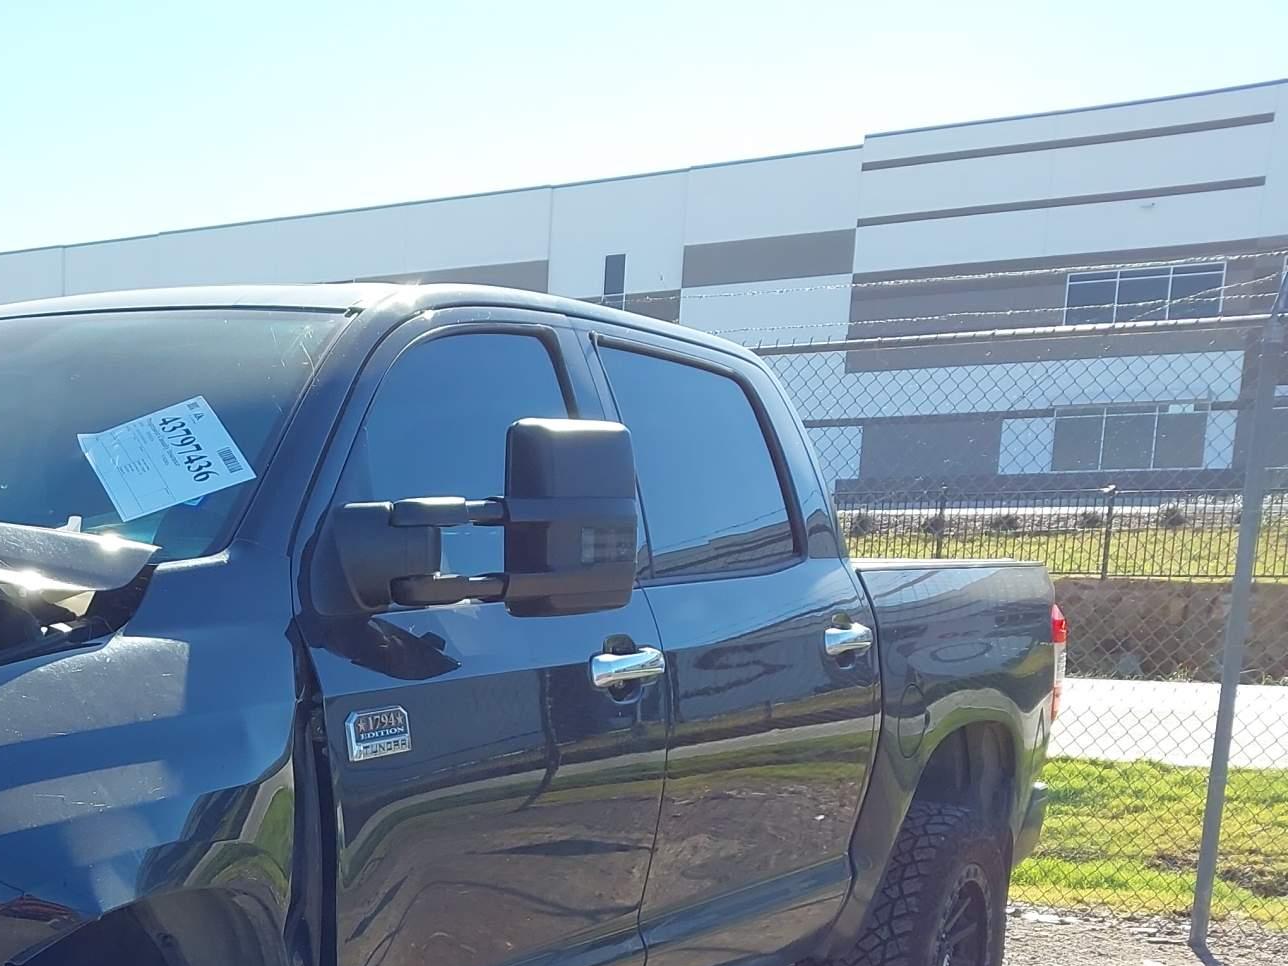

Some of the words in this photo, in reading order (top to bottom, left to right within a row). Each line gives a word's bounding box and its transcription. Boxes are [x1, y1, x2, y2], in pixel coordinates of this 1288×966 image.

[159, 416, 219, 482] 43797436
[368, 711, 395, 730] 1794
[360, 725, 404, 740] EDITION
